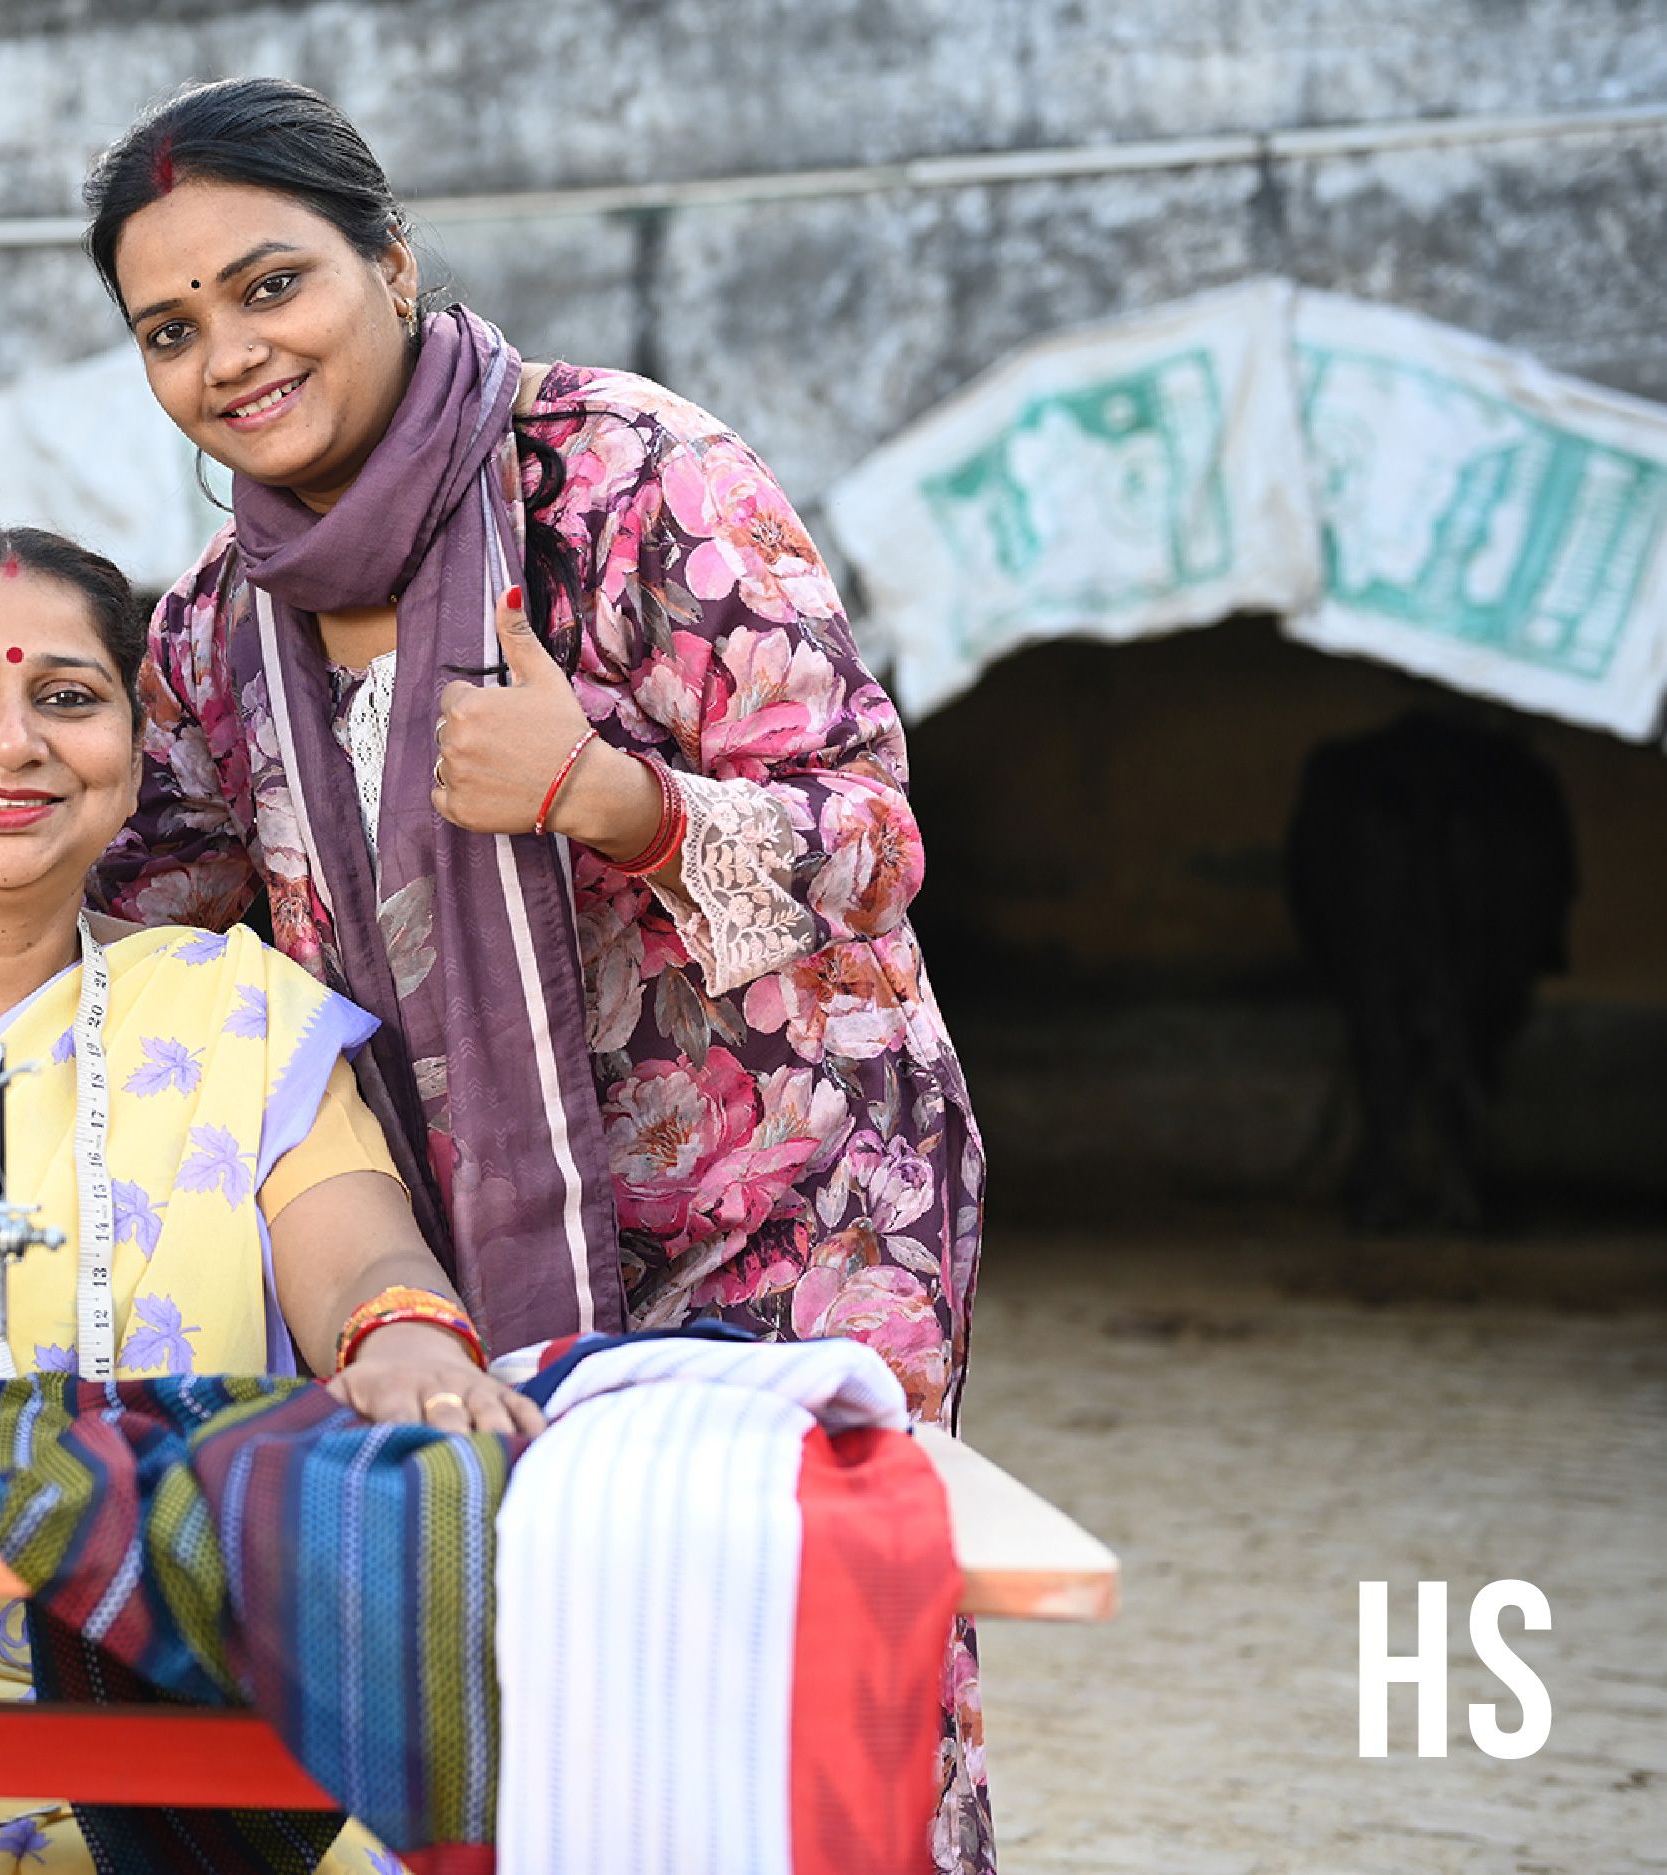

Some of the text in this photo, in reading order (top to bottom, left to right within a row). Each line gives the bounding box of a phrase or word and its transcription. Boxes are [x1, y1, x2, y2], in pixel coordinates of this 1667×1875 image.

[94, 969, 107, 990] 21
[87, 1004, 104, 1028] 20
[91, 1072, 104, 1089] 18
[91, 1108, 105, 1129] 17
[87, 1151, 103, 1167] 16
[94, 1184, 107, 1199] 15
[92, 1267, 107, 1286] 13
[94, 1309, 109, 1328] 12
[96, 1357, 110, 1374] 11
